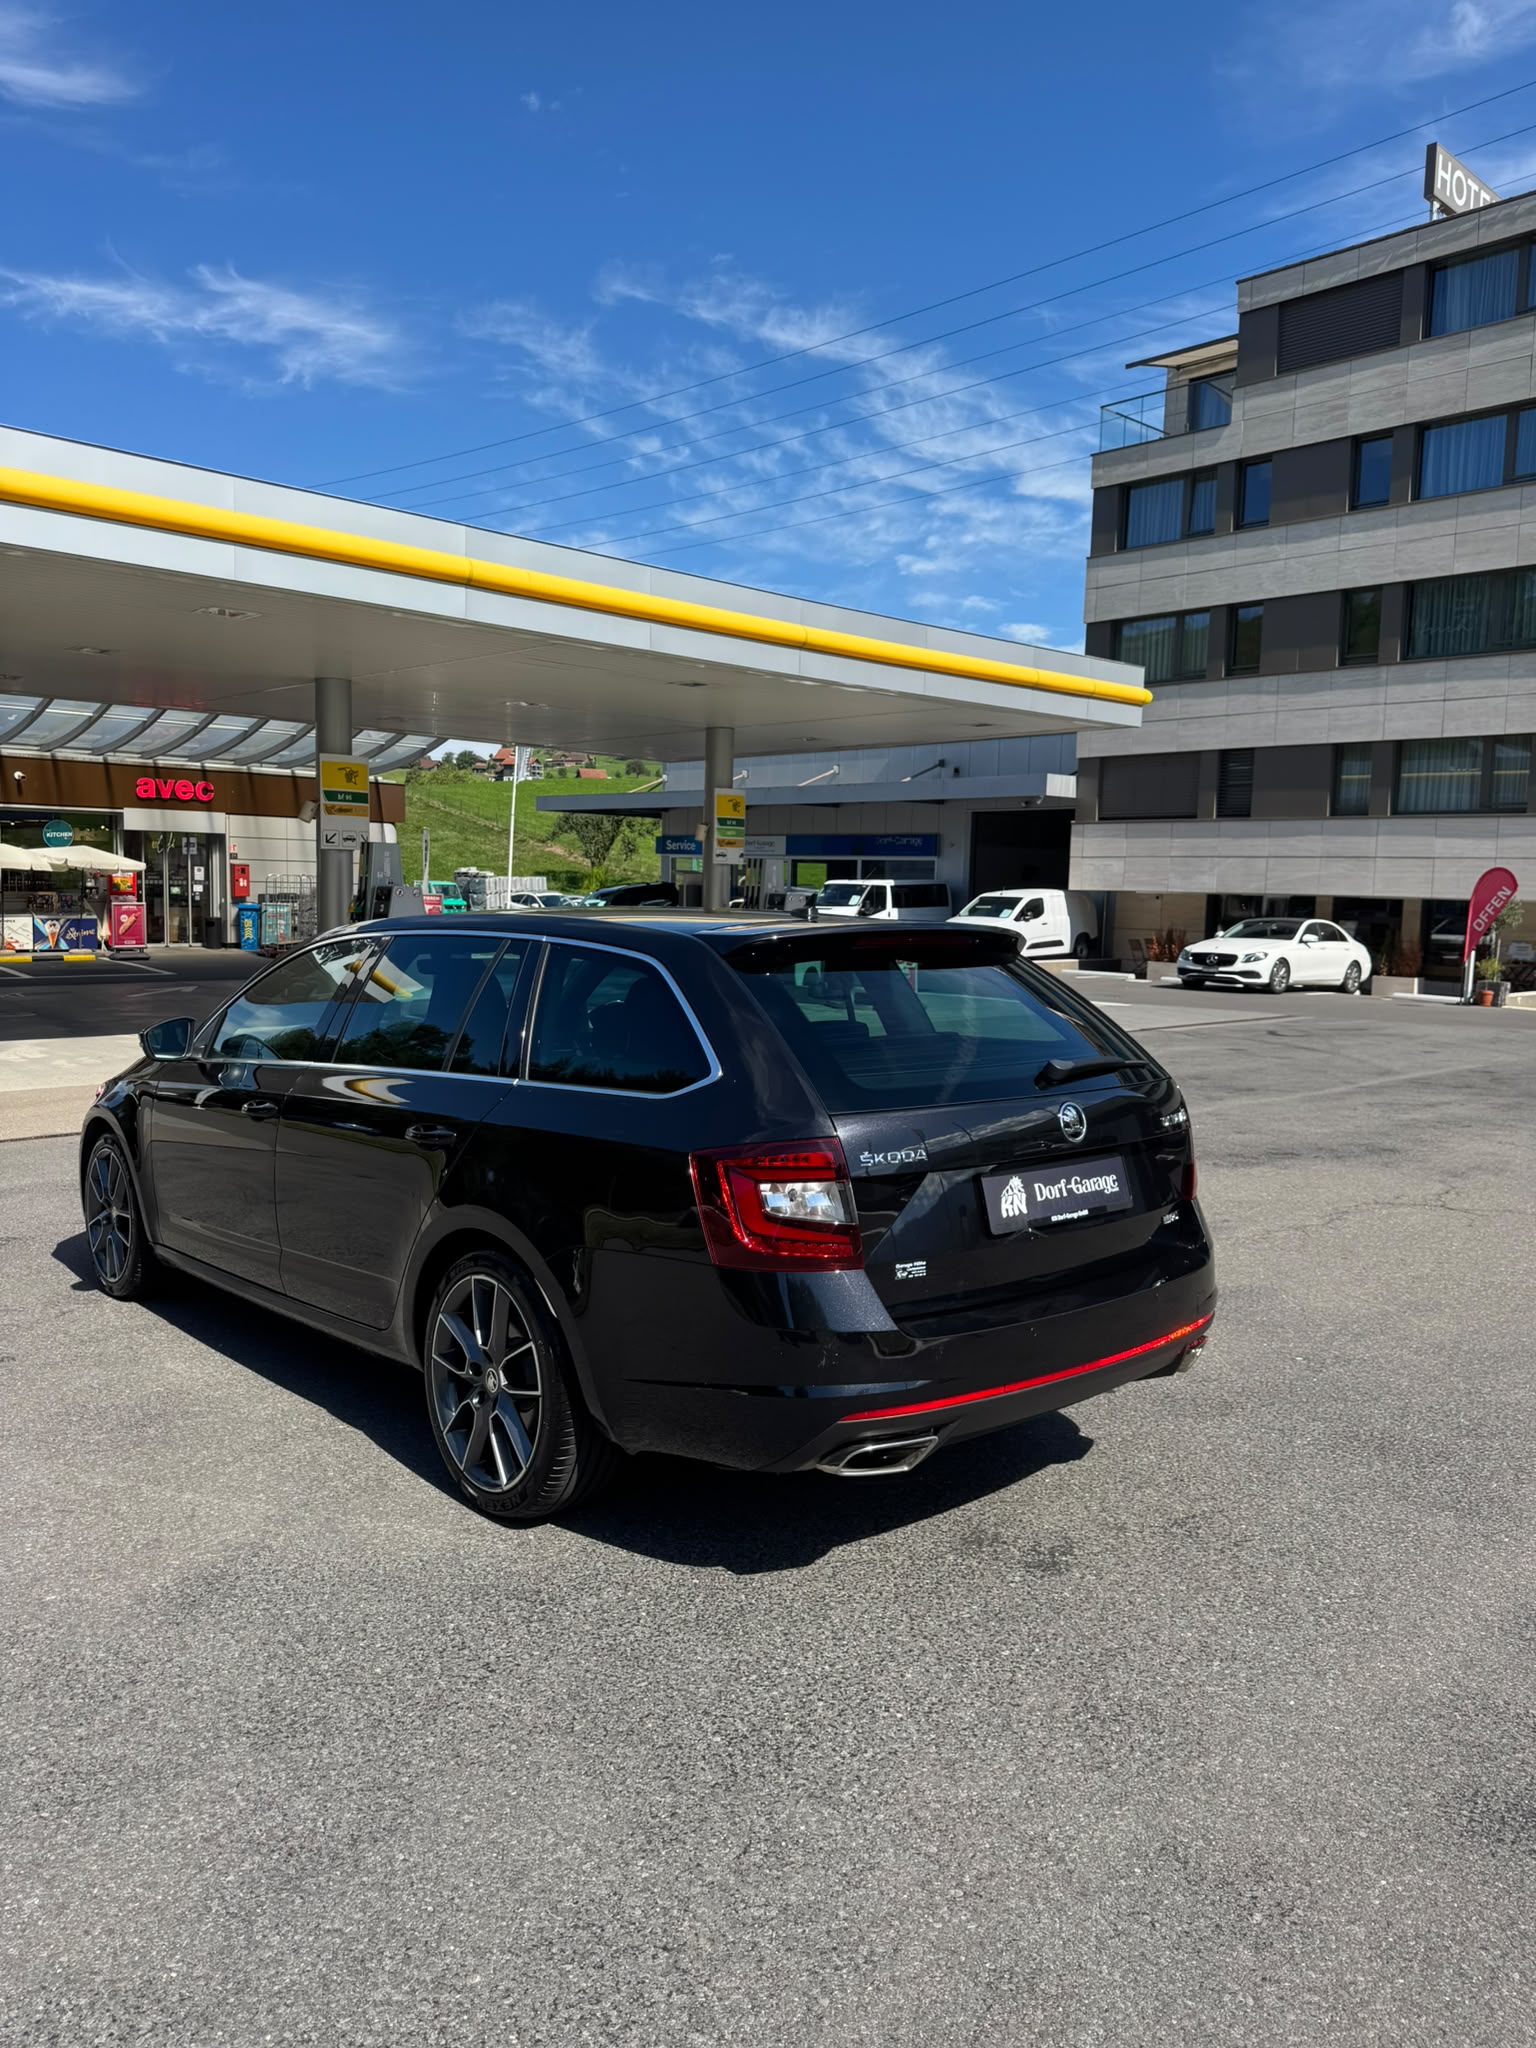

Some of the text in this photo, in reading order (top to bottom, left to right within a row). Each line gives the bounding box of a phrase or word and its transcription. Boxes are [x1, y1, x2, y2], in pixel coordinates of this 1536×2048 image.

[1437, 153, 1495, 209] HOTE
[136, 777, 215, 802] avec
[665, 840, 696, 851] Service
[1472, 886, 1512, 932] OFFEN
[859, 1151, 929, 1167] ŠKODA
[1034, 1174, 1119, 1201] Dorf-Garage
[1001, 1192, 1028, 1219] KN
